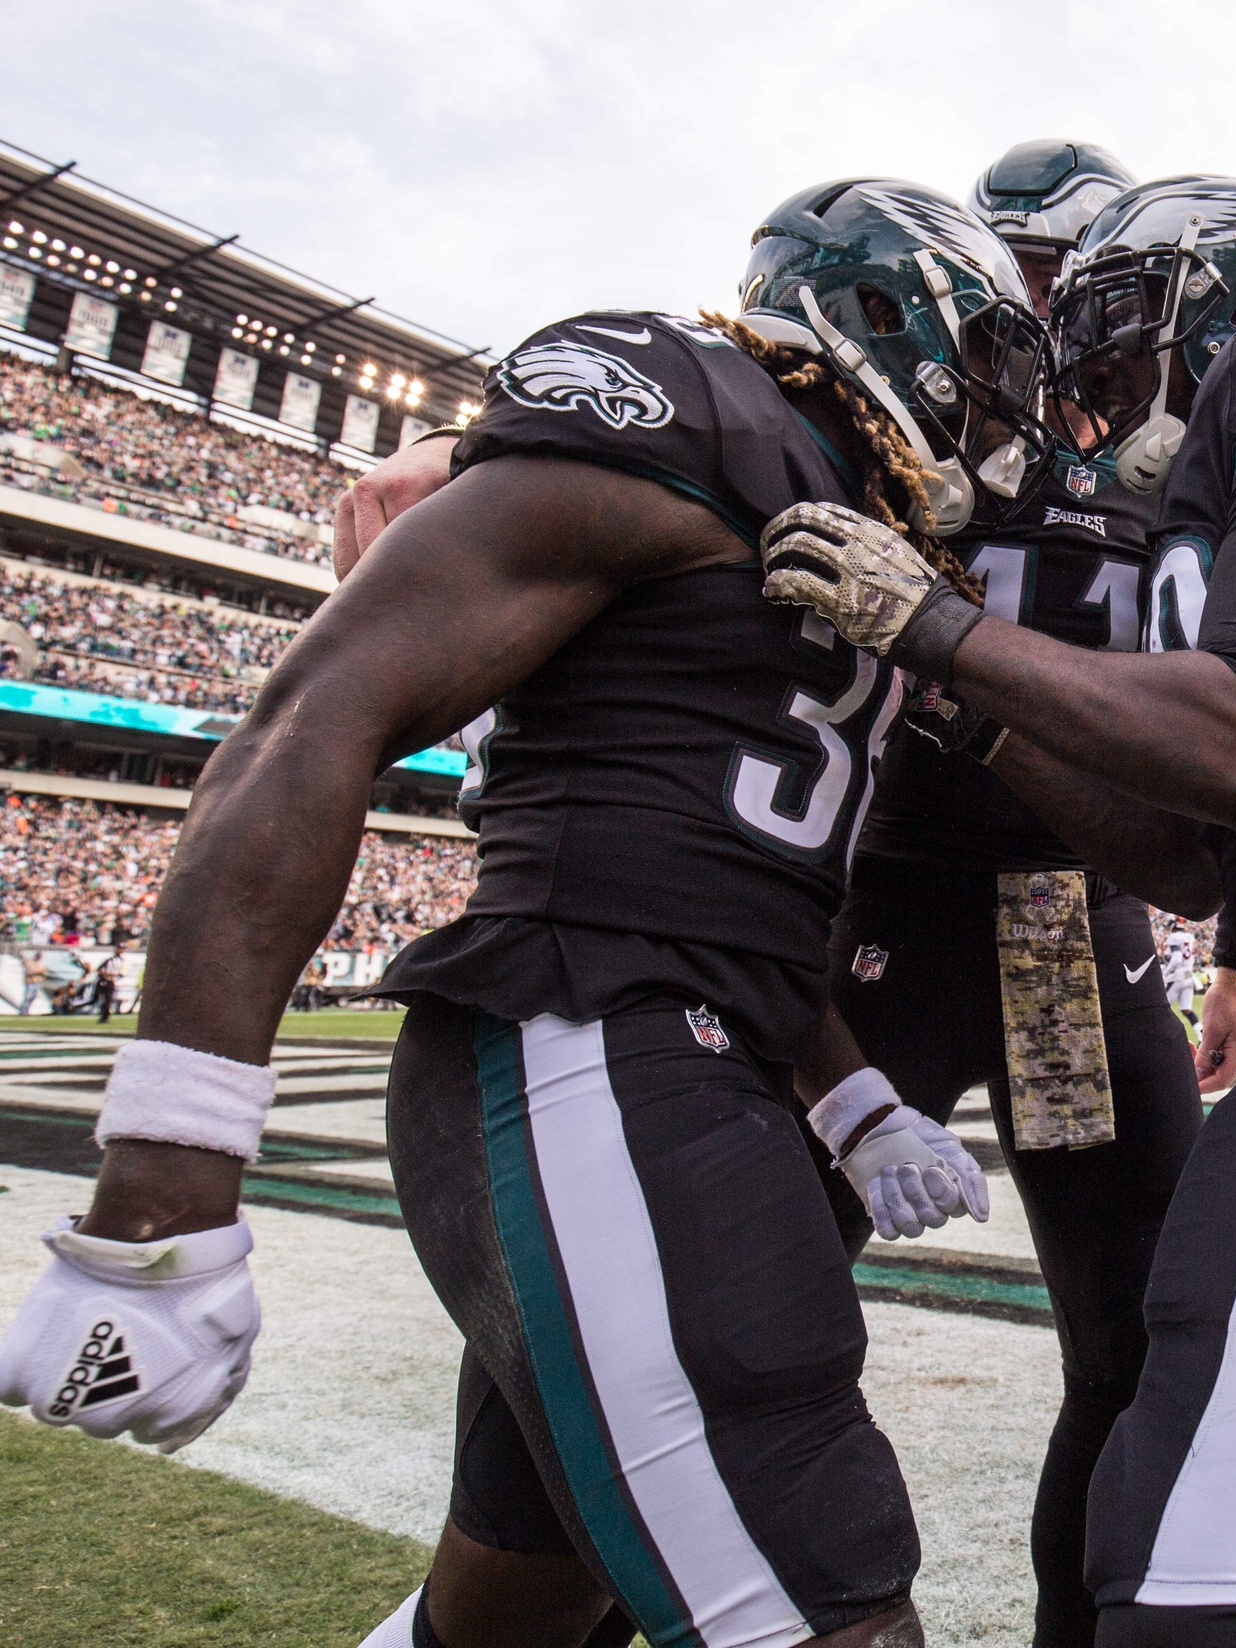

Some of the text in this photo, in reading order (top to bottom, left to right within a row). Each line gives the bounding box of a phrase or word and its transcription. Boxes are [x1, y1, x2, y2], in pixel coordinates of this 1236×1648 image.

[1071, 476, 1091, 492] NFL
[1043, 505, 1107, 538] EAGLES
[1012, 923, 1065, 940] Wilson
[321, 952, 398, 987] PH
[856, 958, 879, 976] NFL
[696, 1026, 725, 1046] NFL
[48, 1320, 115, 1419] adidas
